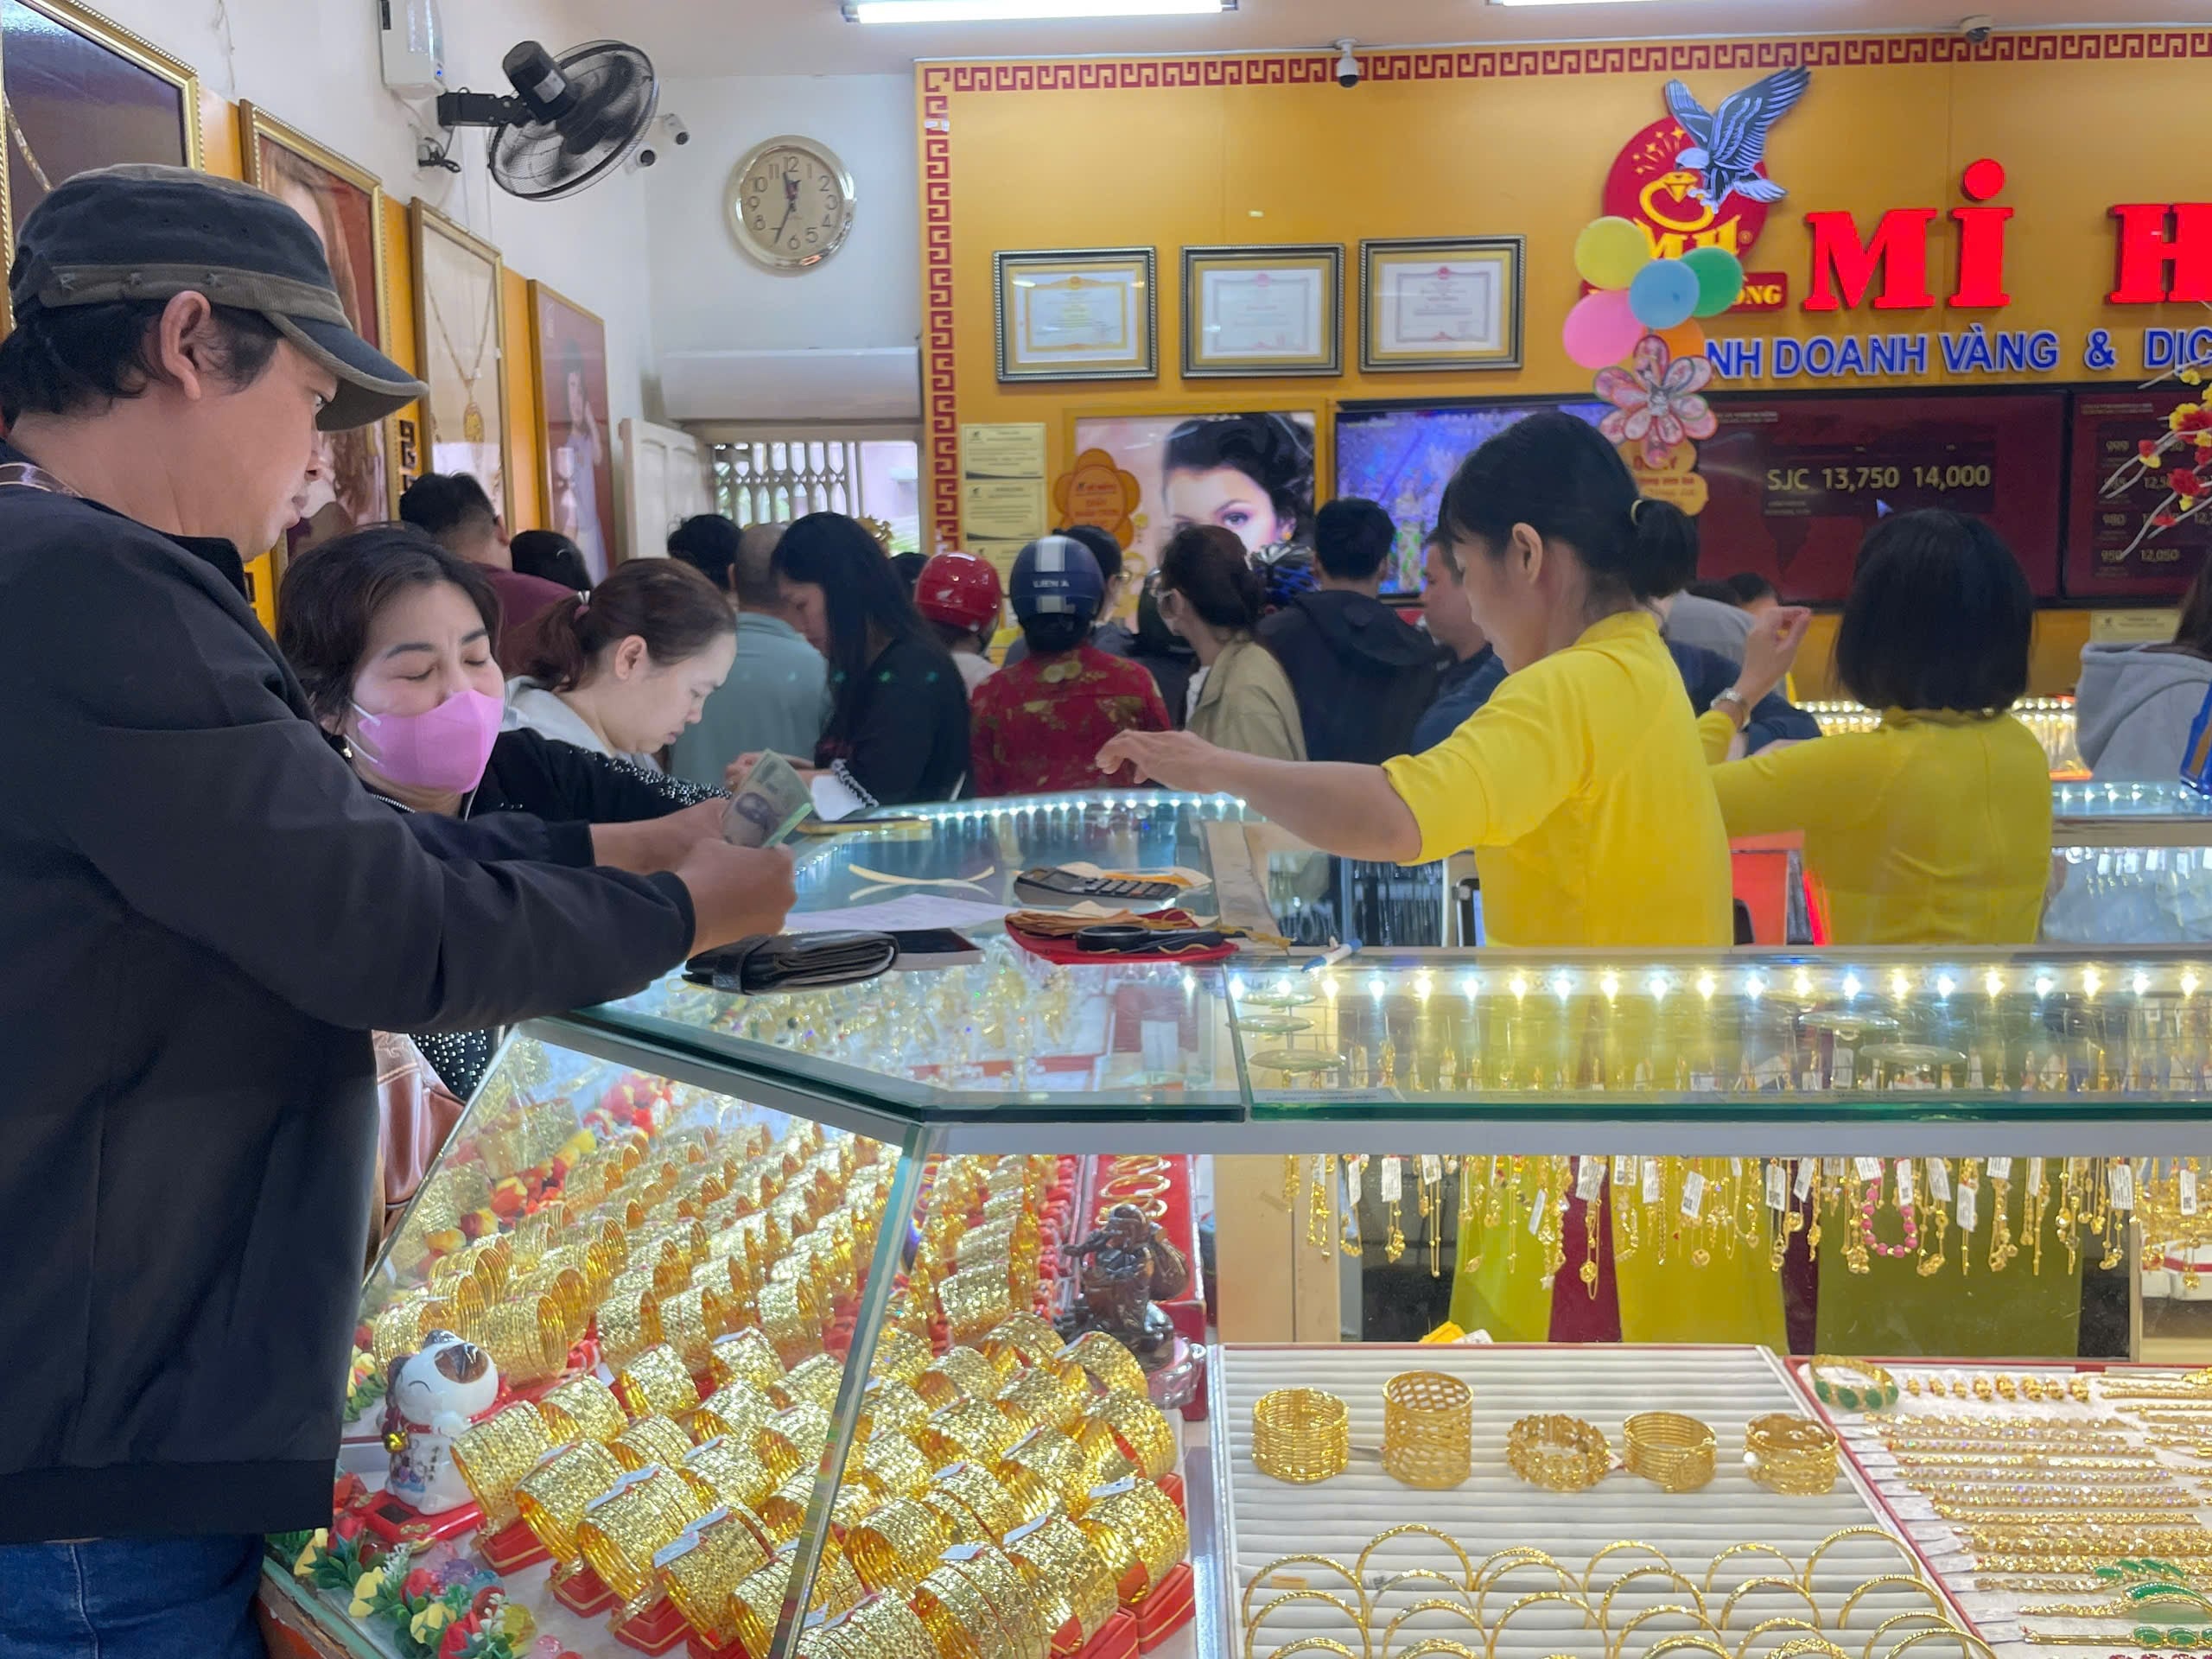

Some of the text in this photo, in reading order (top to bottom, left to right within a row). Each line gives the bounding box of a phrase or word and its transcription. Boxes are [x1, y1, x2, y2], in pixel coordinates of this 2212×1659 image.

[1772, 332, 1928, 378] DOANH
[1938, 323, 2060, 373] VÀNG
[2083, 327, 2118, 370] &
[1767, 464, 1991, 493] SJC 13,750 14,000
